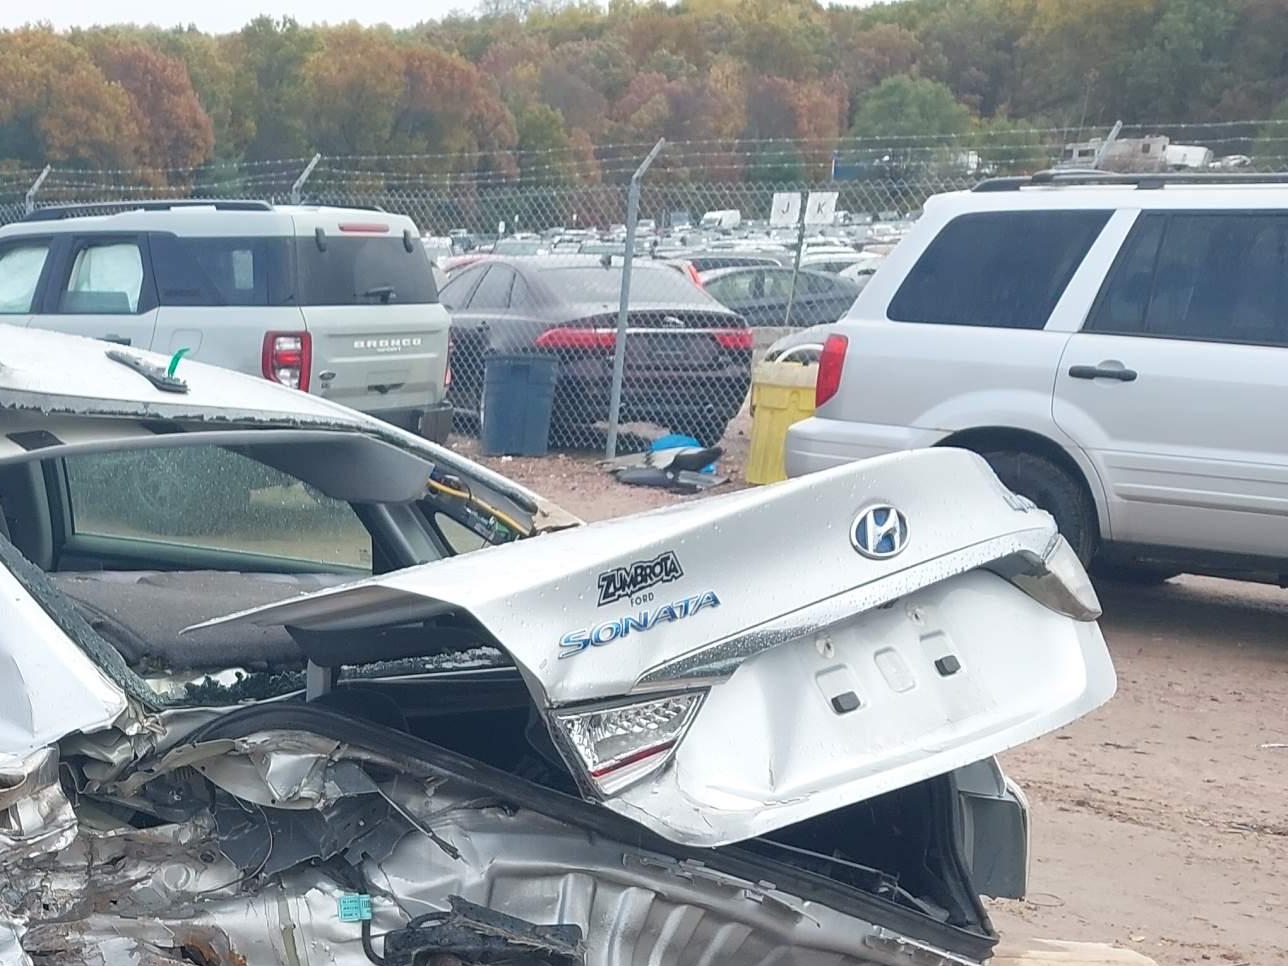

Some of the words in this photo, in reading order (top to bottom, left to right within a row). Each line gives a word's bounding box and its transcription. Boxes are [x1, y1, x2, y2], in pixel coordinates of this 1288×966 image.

[781, 201, 790, 214] J
[817, 201, 825, 215] K
[354, 337, 421, 348] BRONCO
[598, 552, 682, 603] ZUMBROTA
[630, 592, 654, 607] FORD
[558, 591, 721, 660] SONATA
